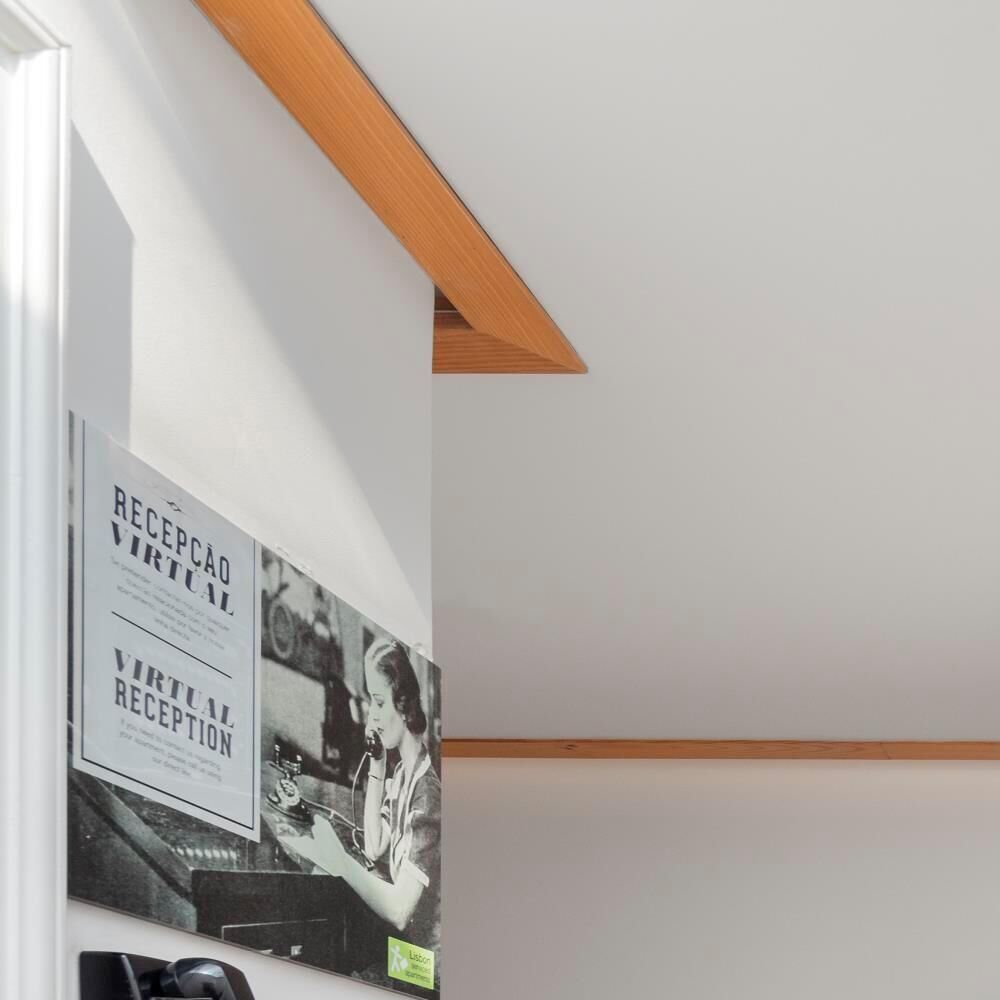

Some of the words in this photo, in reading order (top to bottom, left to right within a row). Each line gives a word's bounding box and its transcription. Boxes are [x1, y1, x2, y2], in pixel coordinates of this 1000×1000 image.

[111, 520, 234, 616] VIRTUAL
[114, 484, 230, 586] RECEPÇÃO
[114, 647, 234, 729] VIRTUAL
[114, 677, 232, 759] RECEPTION
[409, 950, 431, 964] Lisbon
